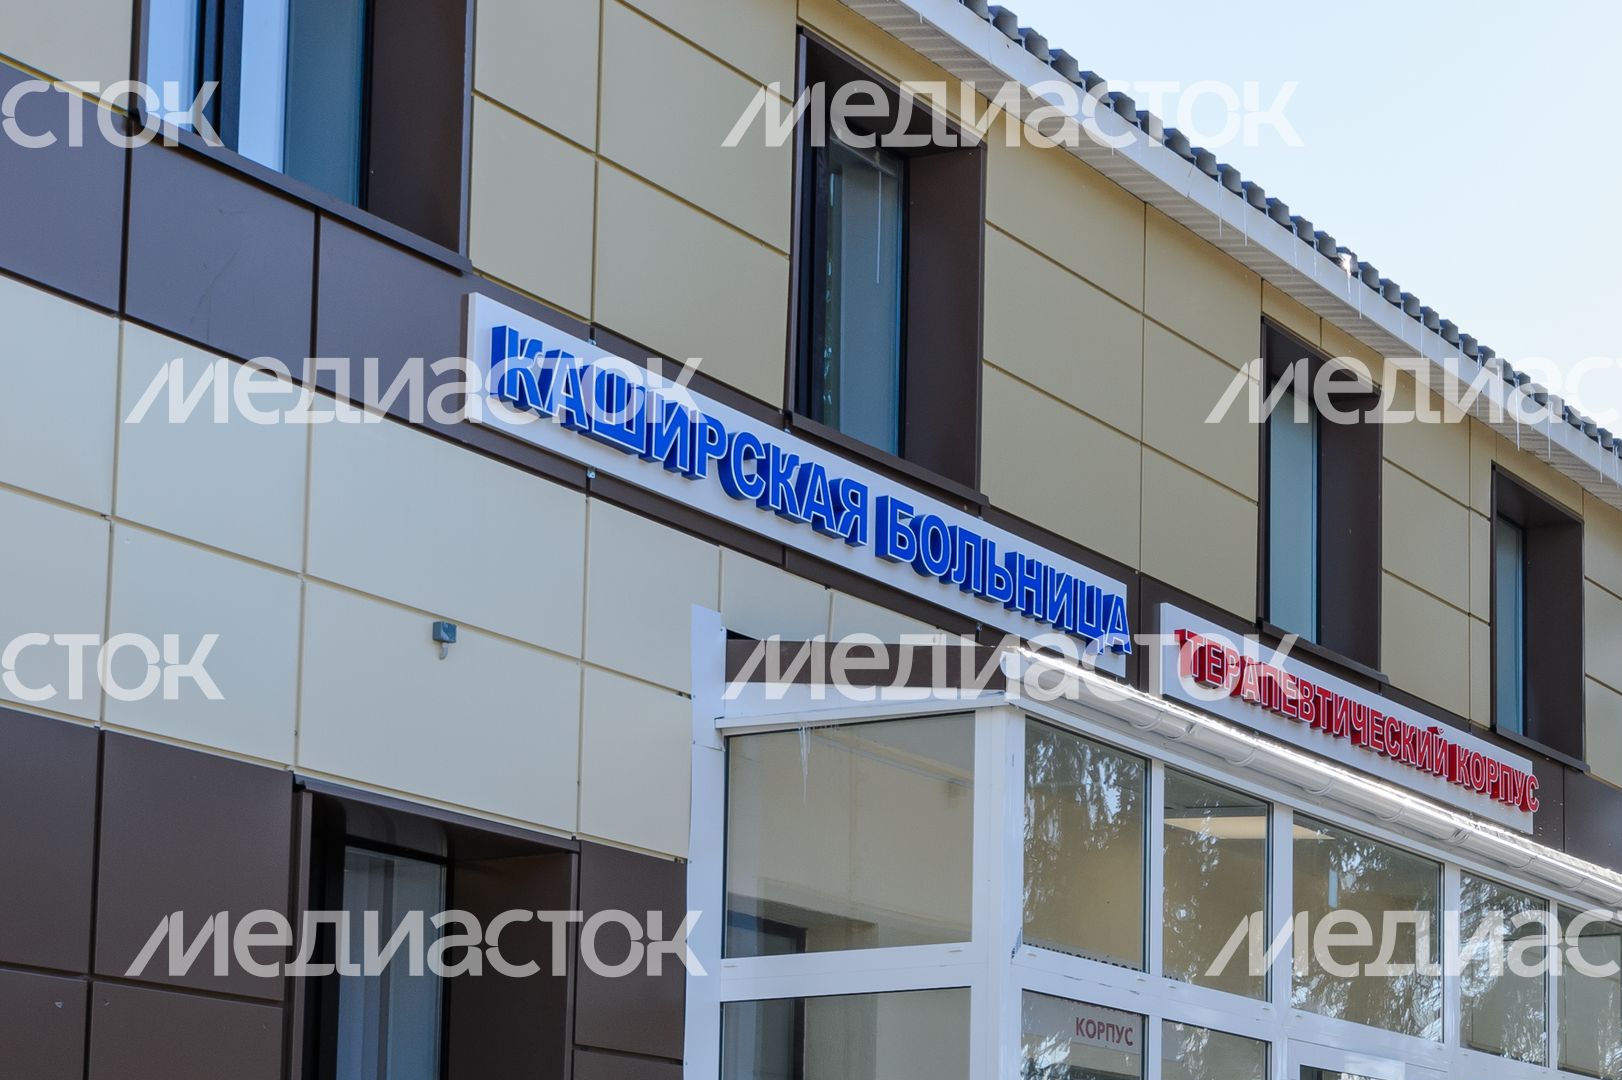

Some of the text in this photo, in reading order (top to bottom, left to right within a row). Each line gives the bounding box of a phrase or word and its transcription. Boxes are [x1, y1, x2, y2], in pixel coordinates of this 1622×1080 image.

[491, 325, 1132, 655] КАШИРСКАЯ БОЛЬНИЦА
[1174, 628, 1540, 813] ТЕРАПЕВТИЧЕСКИЙ КОРПУС
[1076, 1017, 1134, 1046] КОРПУС
